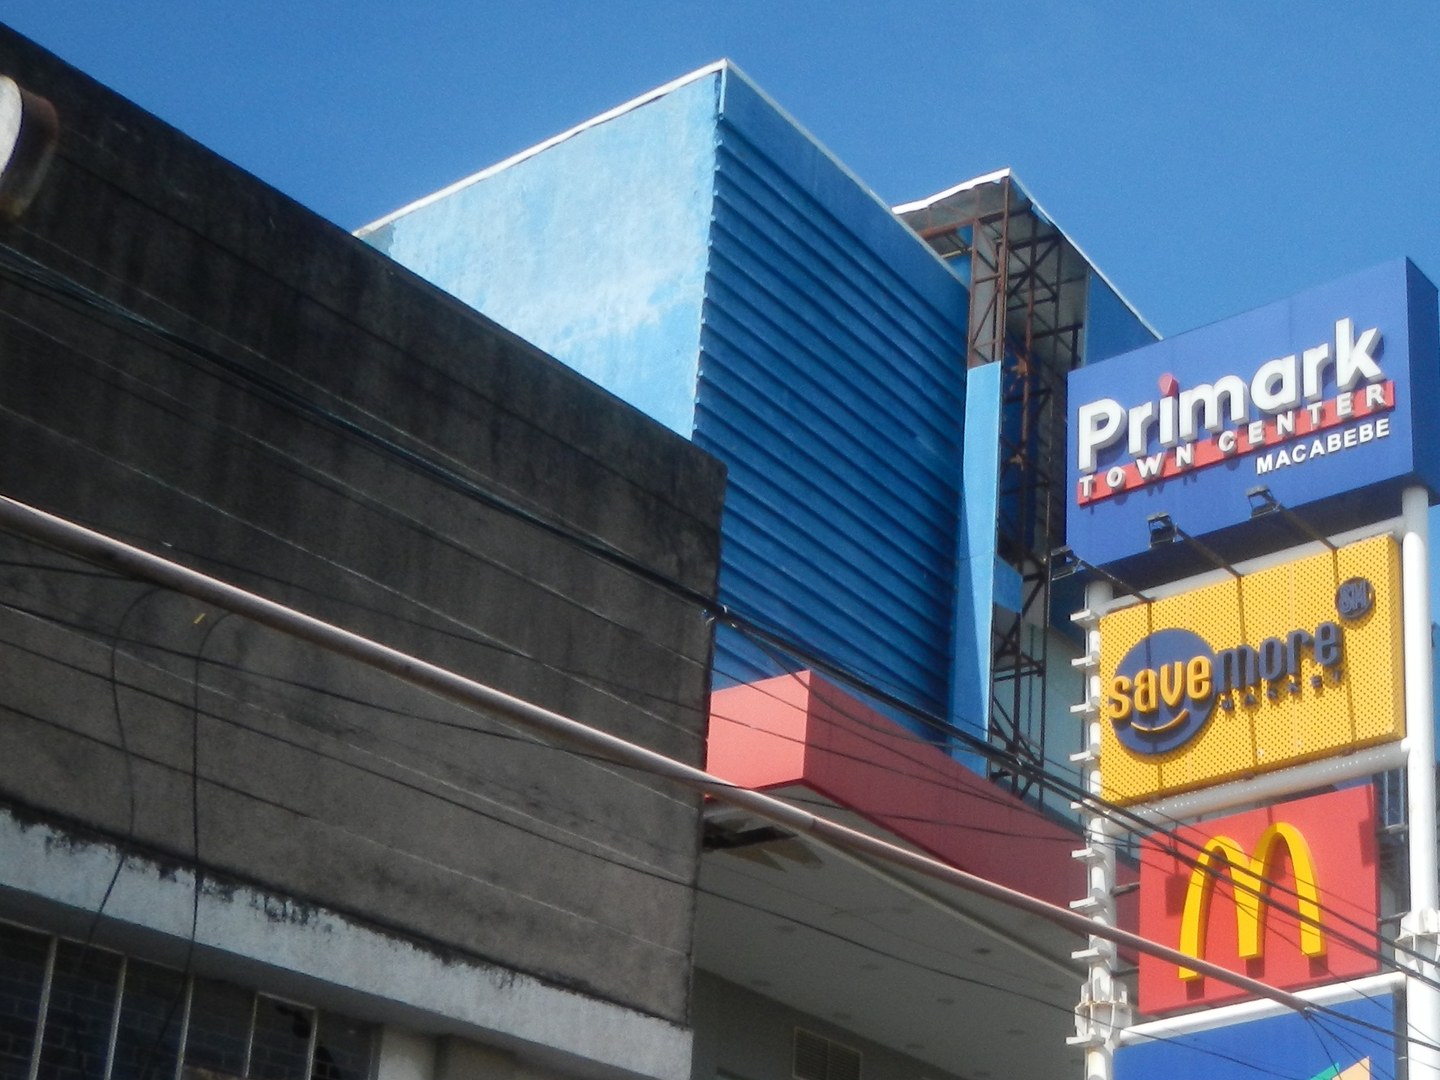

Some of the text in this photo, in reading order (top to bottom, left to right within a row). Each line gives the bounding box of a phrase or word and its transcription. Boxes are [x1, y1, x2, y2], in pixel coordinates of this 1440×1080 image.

[1078, 317, 1385, 473] Primark
[1079, 383, 1386, 498] TOWN CENTER
[1256, 418, 1390, 475] MACABEBE
